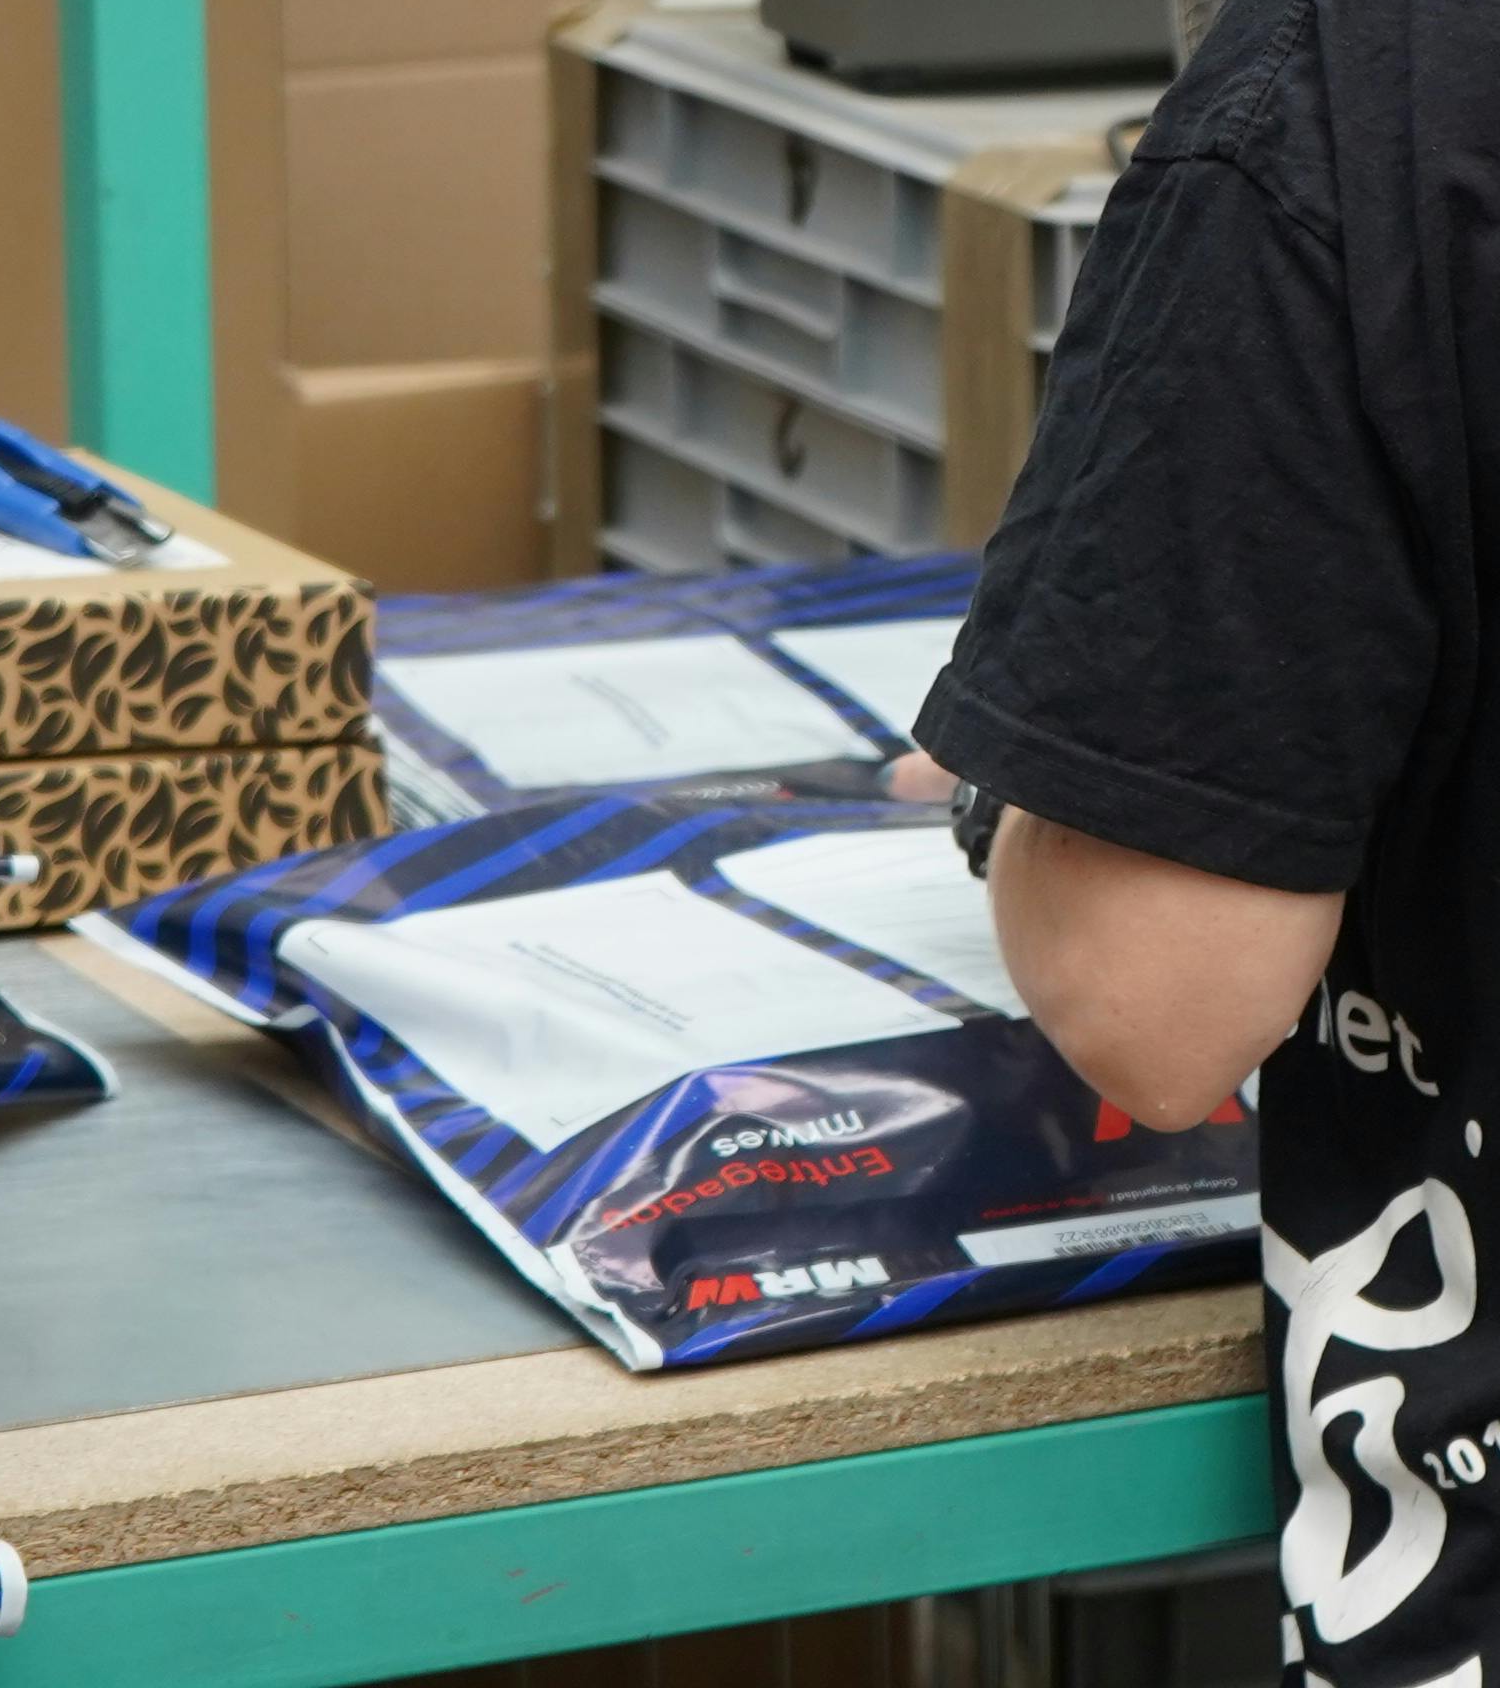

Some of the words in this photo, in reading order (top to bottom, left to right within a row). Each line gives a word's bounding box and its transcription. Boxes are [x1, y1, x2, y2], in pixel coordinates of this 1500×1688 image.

[710, 1109, 865, 1159] mrw.es
[601, 1146, 894, 1232] Entregados
[686, 1256, 890, 1311] MRW
